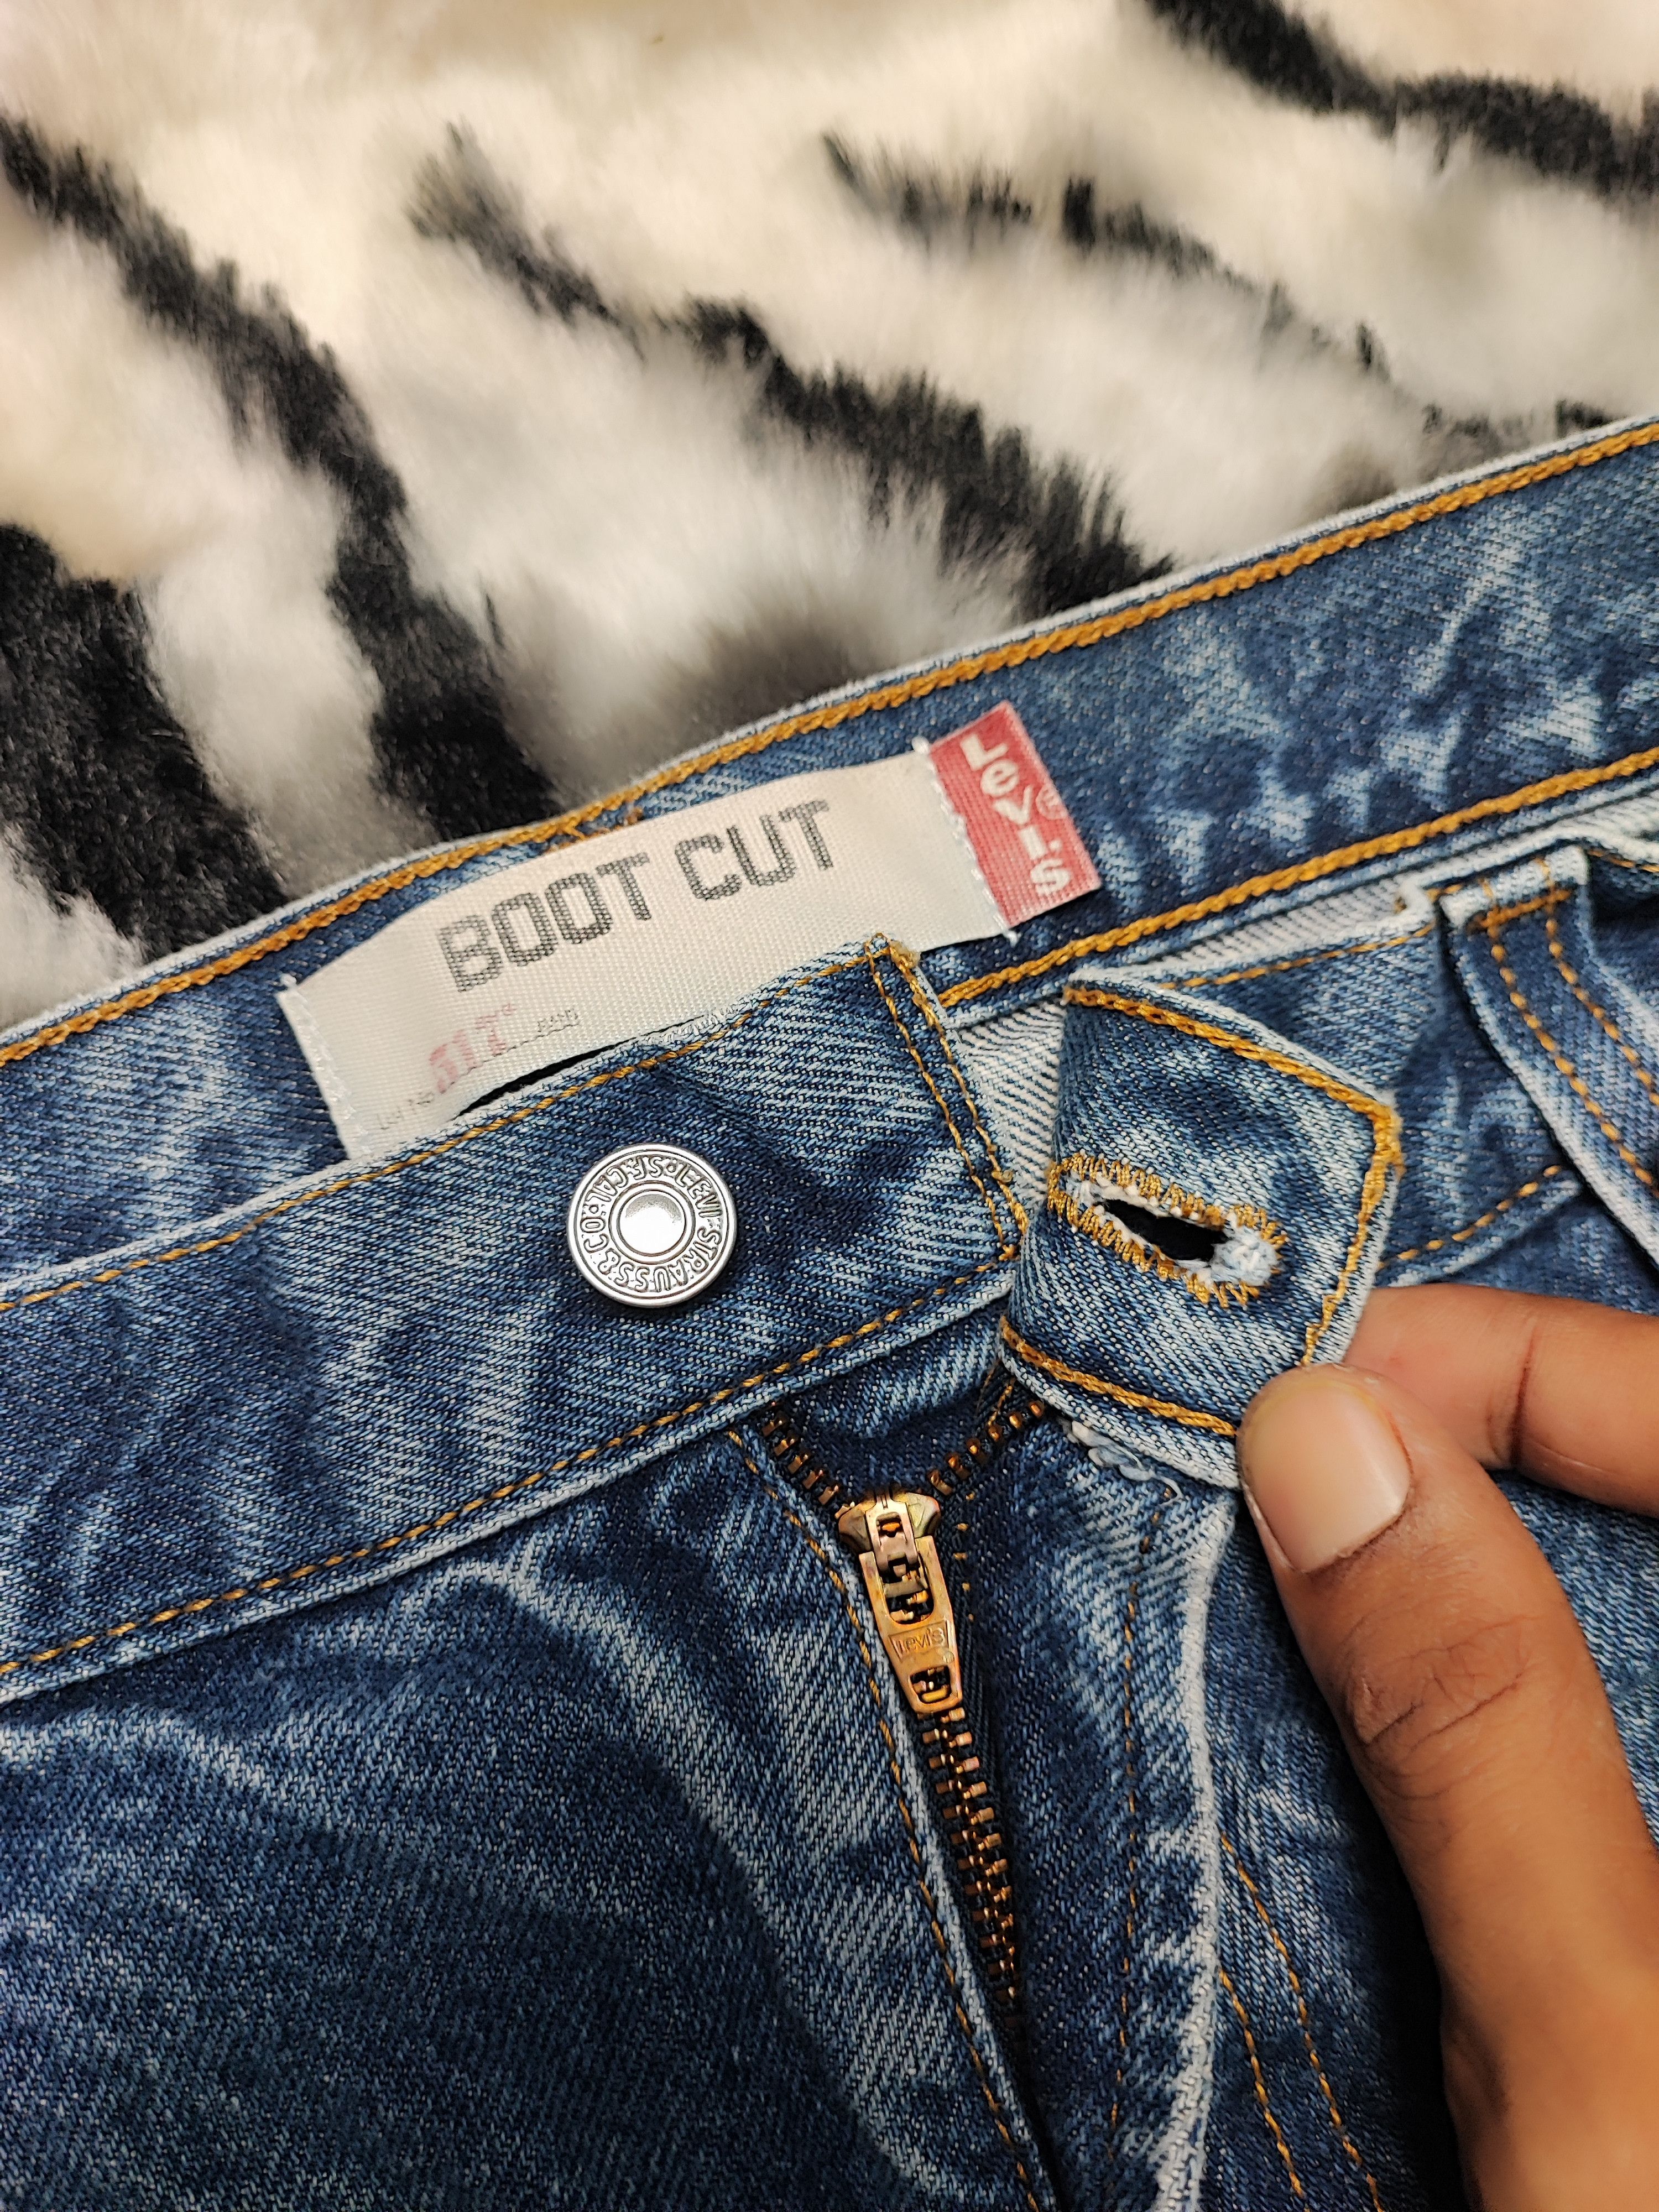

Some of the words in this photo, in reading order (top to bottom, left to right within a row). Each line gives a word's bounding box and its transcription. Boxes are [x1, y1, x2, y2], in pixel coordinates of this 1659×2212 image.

[436, 851, 653, 993] BOOT
[674, 799, 834, 901] CUT
[674, 1162, 722, 1218] LEVI
[597, 1247, 622, 1276] &
[613, 1225, 723, 1293] STRAUSS
